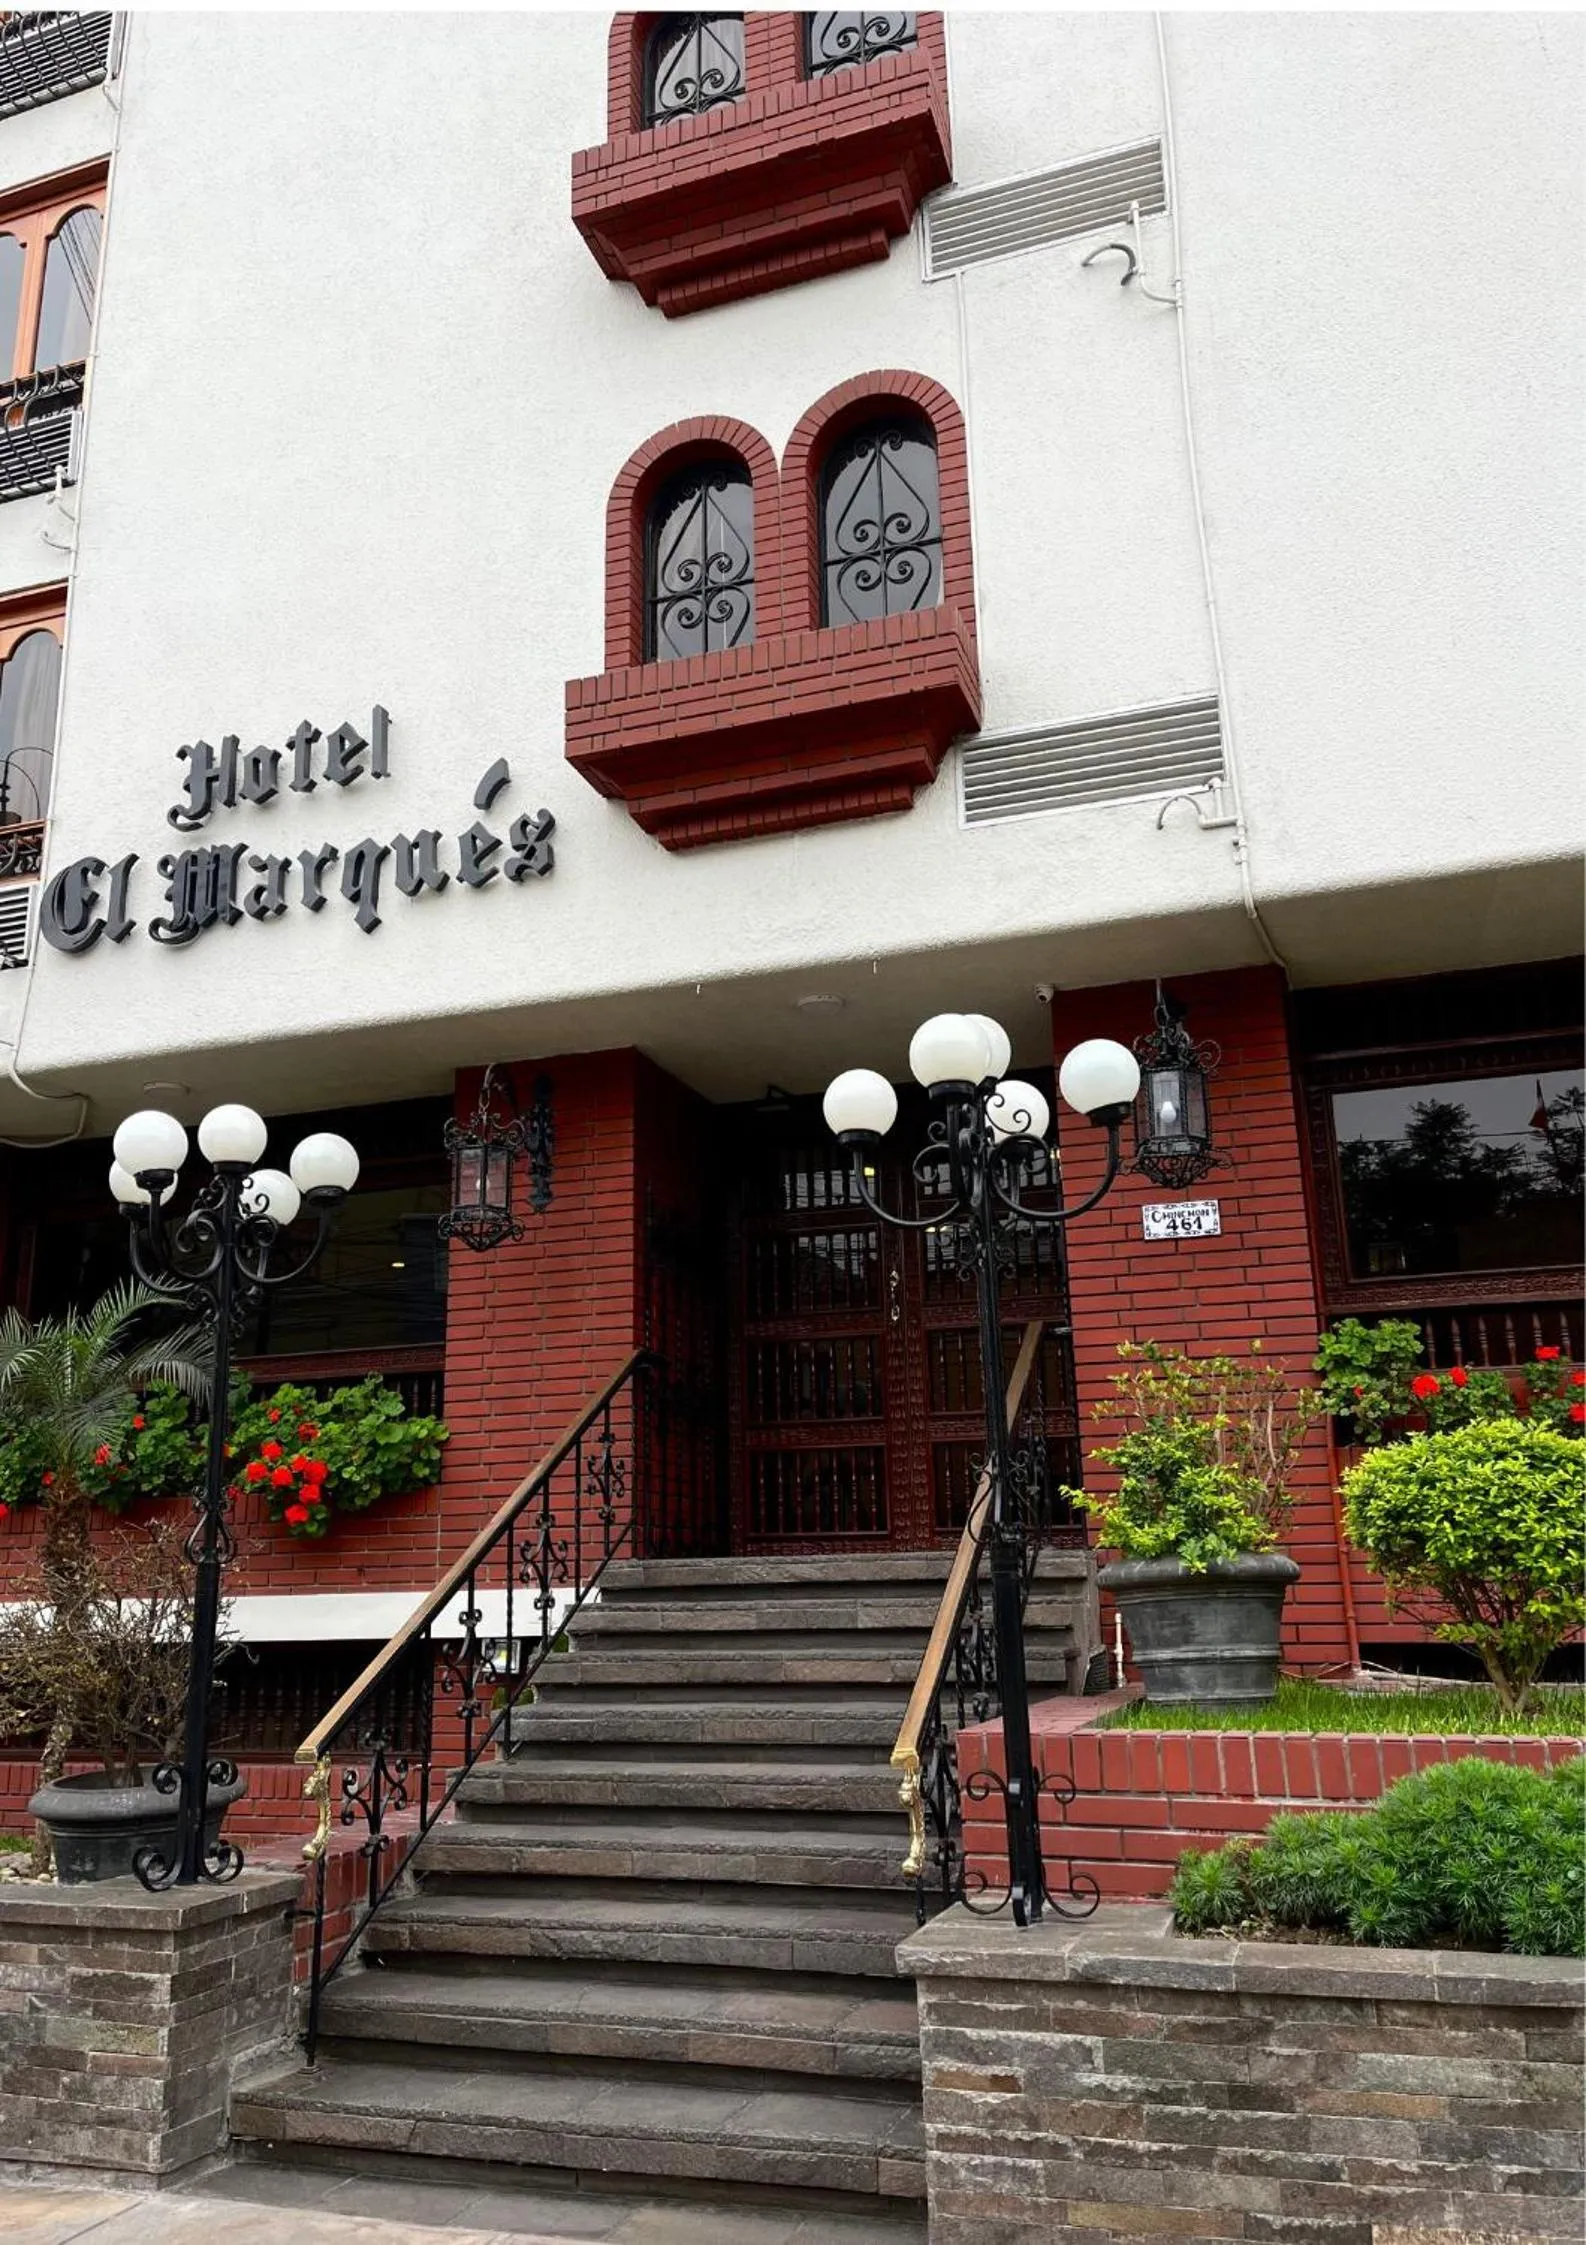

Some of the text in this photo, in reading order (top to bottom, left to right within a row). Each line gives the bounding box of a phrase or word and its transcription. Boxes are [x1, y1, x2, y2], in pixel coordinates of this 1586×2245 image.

[168, 705, 391, 832] Hotel
[41, 758, 557, 953] El Marqués
[1166, 1216, 1202, 1231] 461
